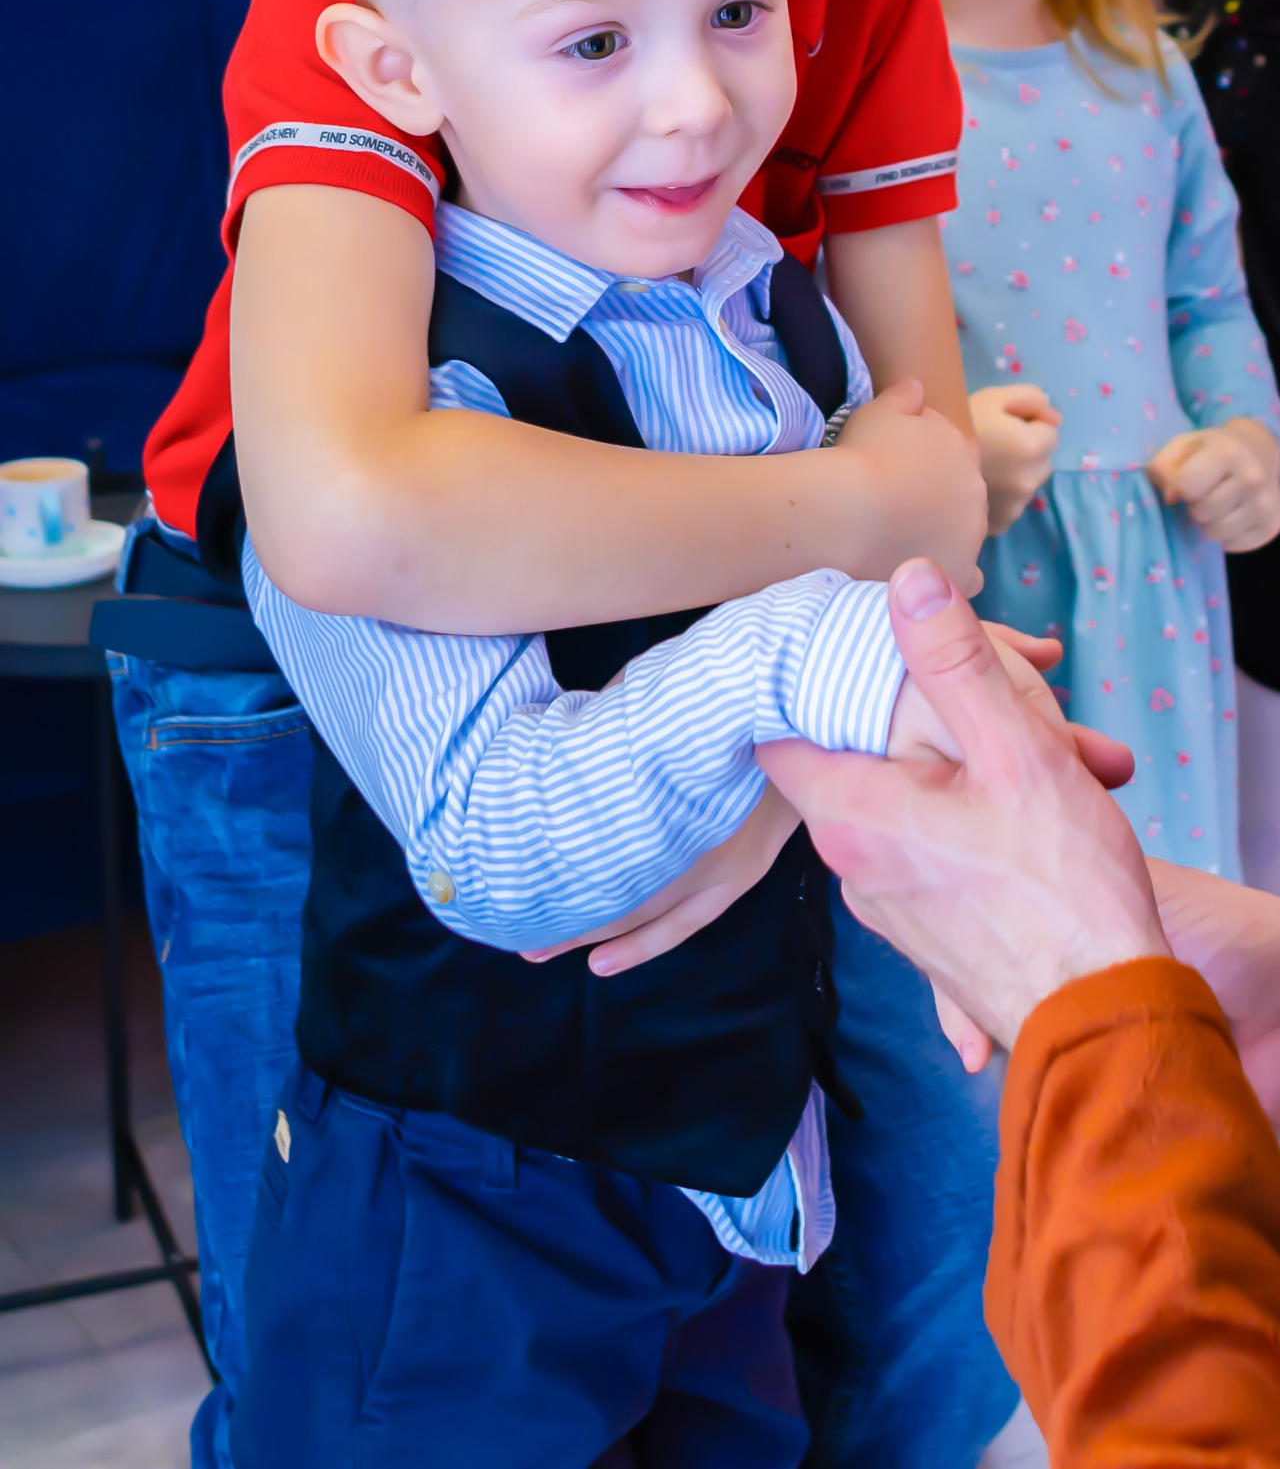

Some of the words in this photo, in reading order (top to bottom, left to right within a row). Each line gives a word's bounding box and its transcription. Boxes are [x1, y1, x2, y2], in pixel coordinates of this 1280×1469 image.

[319, 131, 347, 144] FIND
[349, 134, 415, 167] SOMEPLACE
[415, 160, 432, 181] NEW
